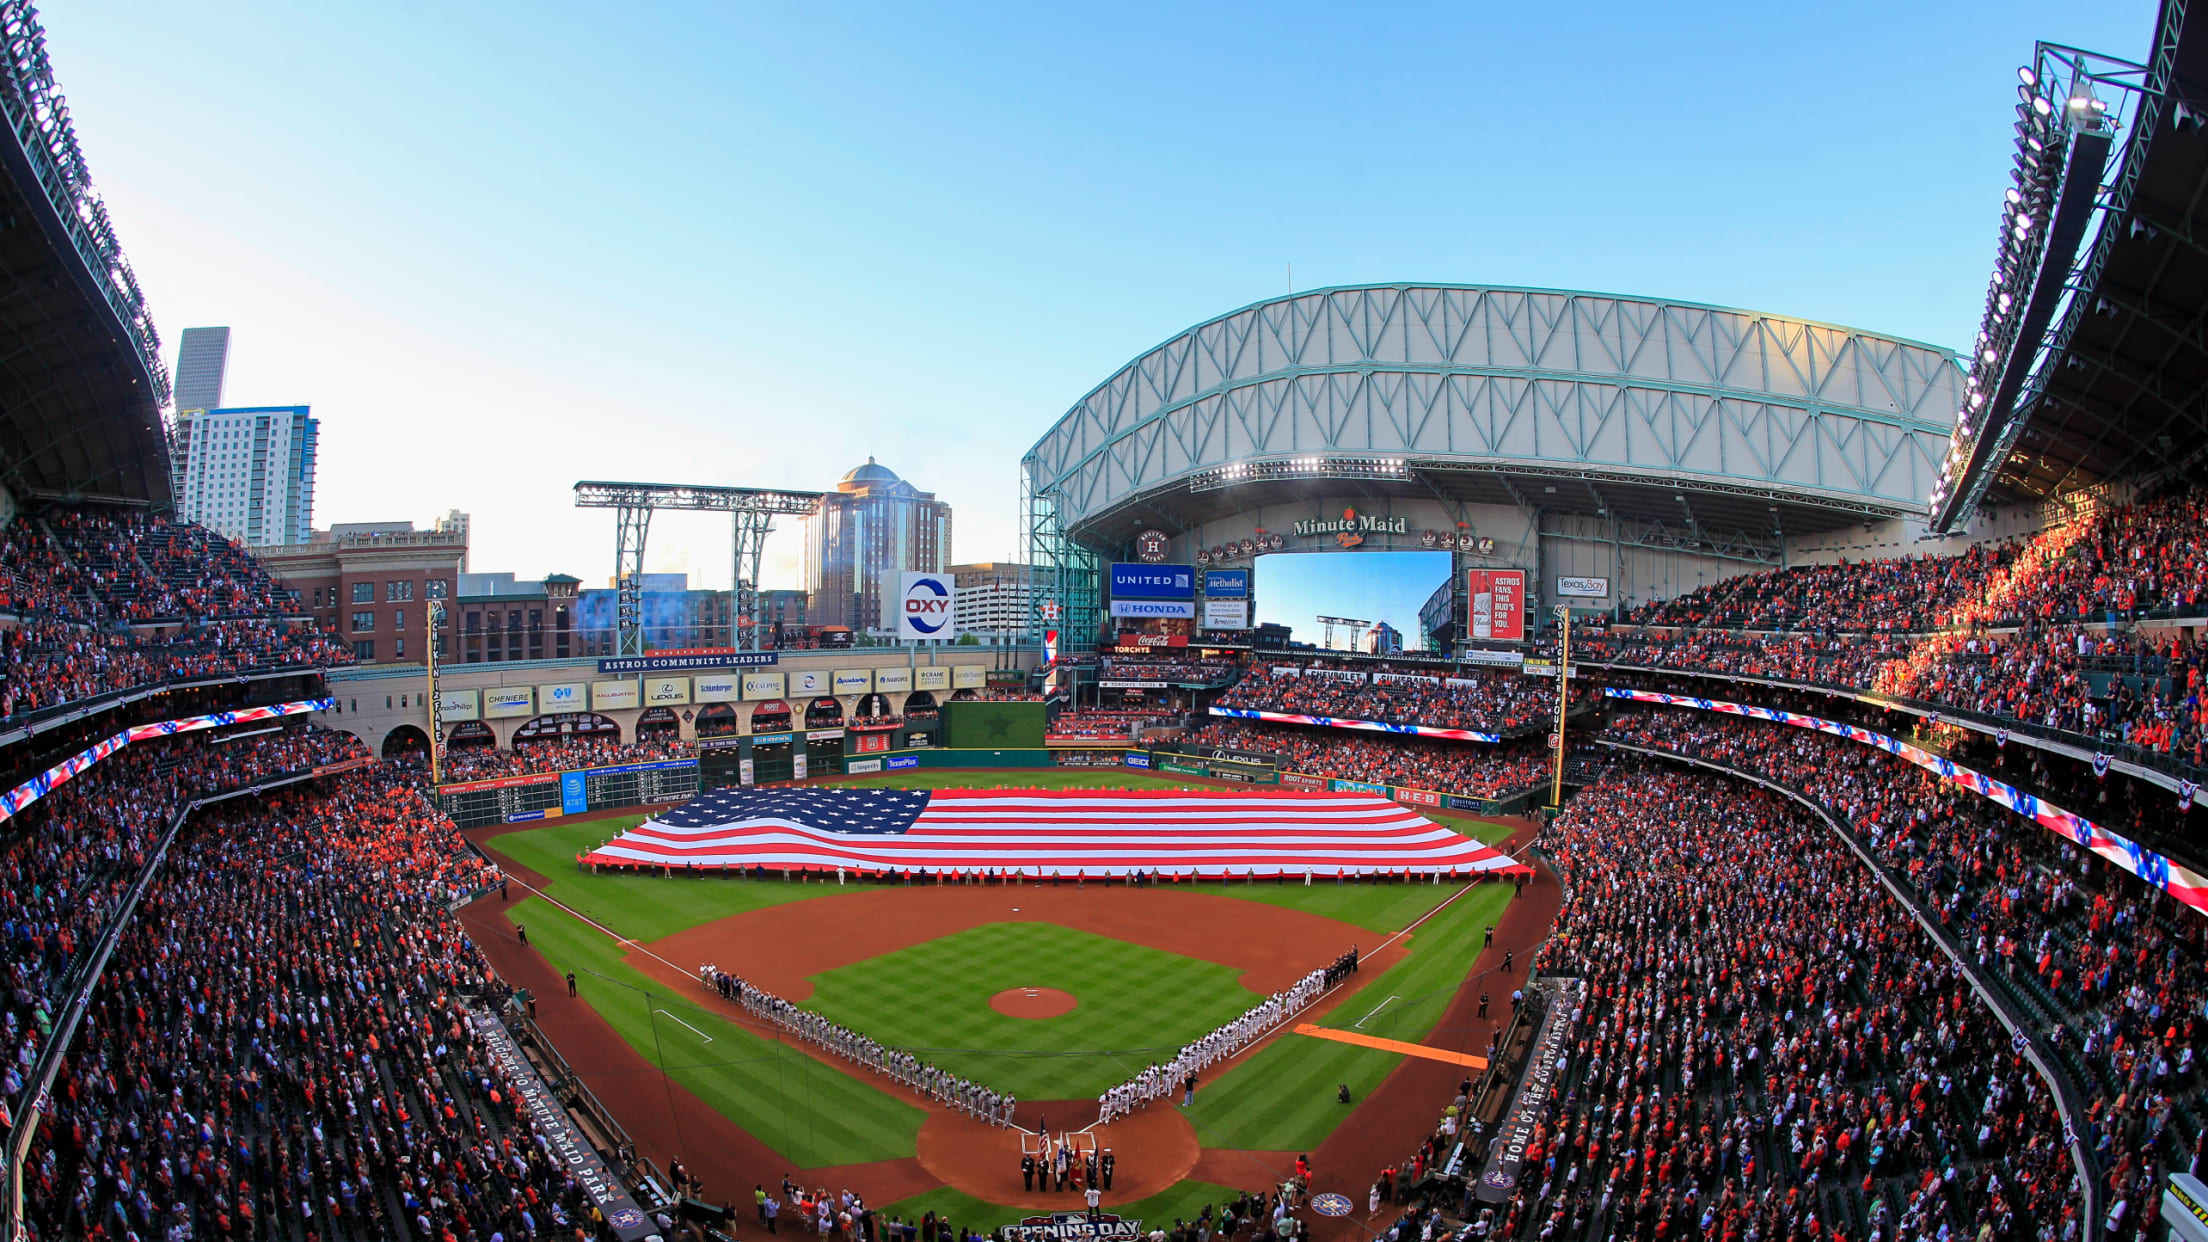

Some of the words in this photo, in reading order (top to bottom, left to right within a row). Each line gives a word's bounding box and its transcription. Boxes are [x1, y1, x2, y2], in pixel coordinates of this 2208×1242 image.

[1293, 517, 1356, 536] Minute
[1359, 515, 1406, 533] Maid
[1117, 576, 1172, 585] UNITED
[1494, 577, 1520, 586] ASTROS
[1560, 578, 1584, 588] Texas
[1586, 578, 1605, 592] Bay
[1495, 586, 1513, 595] FANS,
[1495, 595, 1510, 603] THIS
[906, 599, 950, 613] OXY
[1132, 605, 1187, 614] HONDA
[1494, 602, 1515, 612] BUD'S
[1494, 612, 1508, 620] FOR
[1494, 620, 1510, 629] YOU.
[432, 622, 440, 678] CHIKIN
[605, 660, 648, 670] ASTROS
[652, 657, 722, 667] COMMUNITY
[726, 655, 772, 664] LEADERS
[886, 676, 908, 684] NABORS
[1311, 670, 1362, 682] CHEVROLET
[1380, 674, 1432, 685] SILVERADO
[433, 680, 441, 700] IZ
[488, 693, 529, 703] CHENIERE
[651, 692, 685, 701] LEXUS
[1553, 696, 1561, 733] FOUL
[434, 701, 443, 742] FARE
[888, 758, 916, 768] TexanPlus
[1226, 754, 1262, 764] LEXUS
[1284, 774, 1302, 783] ROOT
[1302, 778, 1323, 786] SPORTS
[566, 797, 584, 807] AT&T
[485, 1030, 520, 1072] WELCOME
[513, 1072, 529, 1086] TO
[522, 1088, 560, 1130] MINUTE
[552, 1132, 584, 1165] MAID
[578, 1168, 609, 1204] PARK
[1505, 1126, 1530, 1162] HOME
[1528, 1083, 1545, 1105] THE
[1003, 1223, 1096, 1240] OPENING
[1098, 1221, 1139, 1235] DAY
